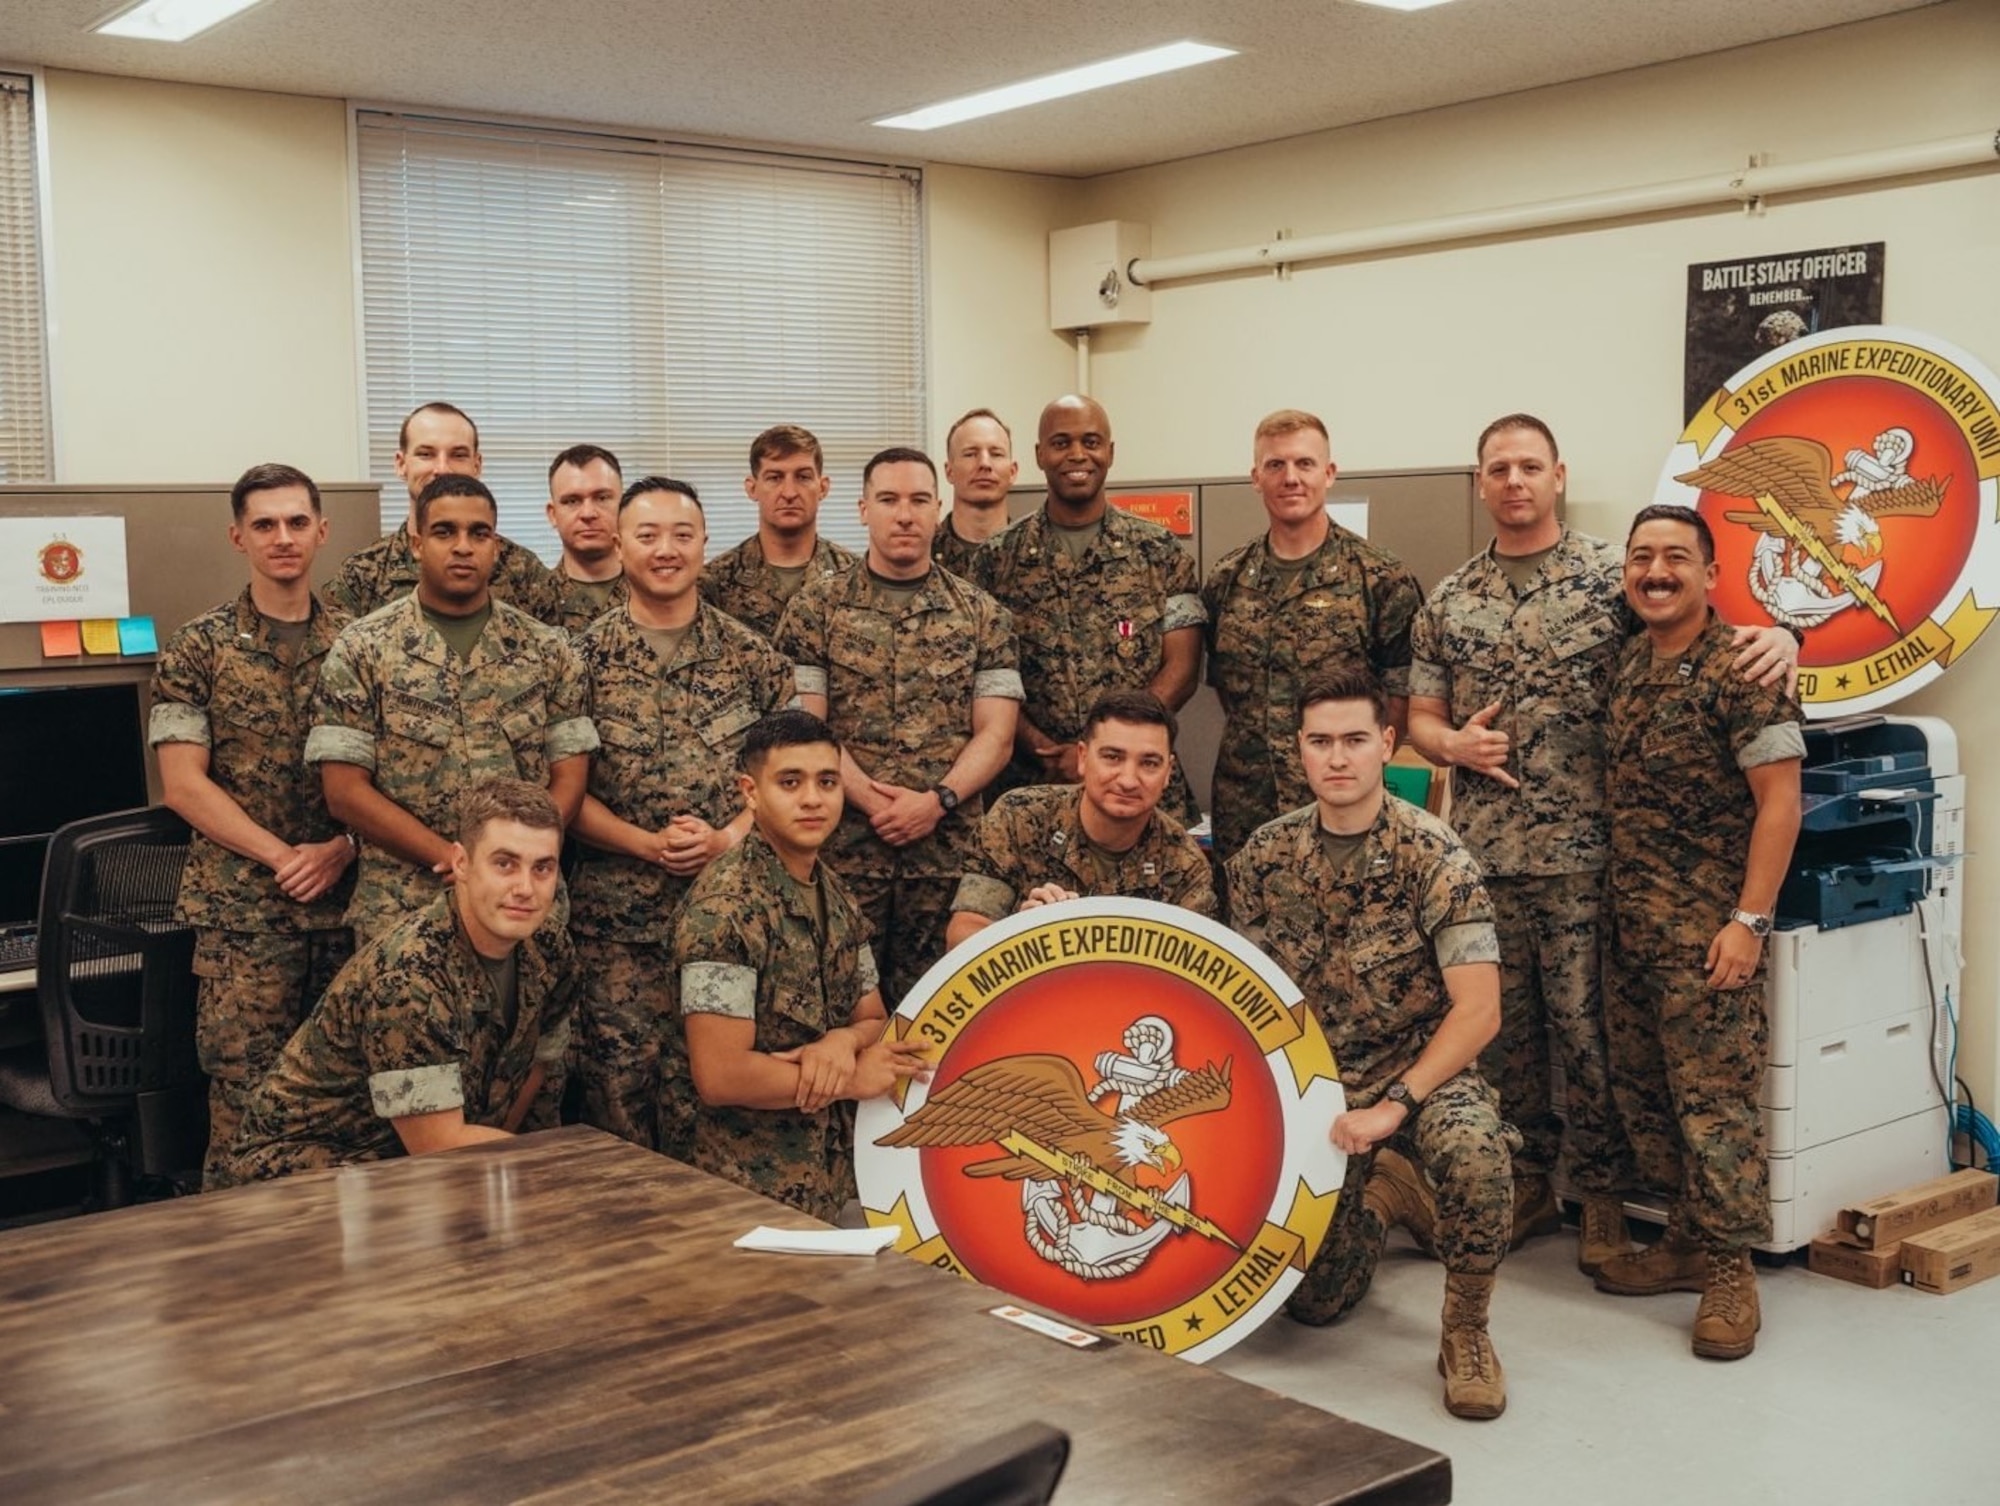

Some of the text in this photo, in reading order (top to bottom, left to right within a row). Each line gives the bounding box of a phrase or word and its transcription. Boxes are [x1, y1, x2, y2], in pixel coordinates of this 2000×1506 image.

[1702, 251, 1867, 291] BATTLE STAFF OFFICER
[1734, 378, 1777, 416] 31st
[1780, 348, 1850, 388] MARINE
[1855, 346, 1985, 420] EXPEDITIONARY
[1865, 636, 1935, 686] LETHAL
[920, 990, 974, 1045] 31st
[967, 934, 1057, 997] MARINE
[1059, 925, 1240, 990] EXPEDITIONARY
[1232, 980, 1283, 1032] UNIT
[1106, 1178, 1132, 1199] FROM
[1212, 1245, 1286, 1316] LETHAL
